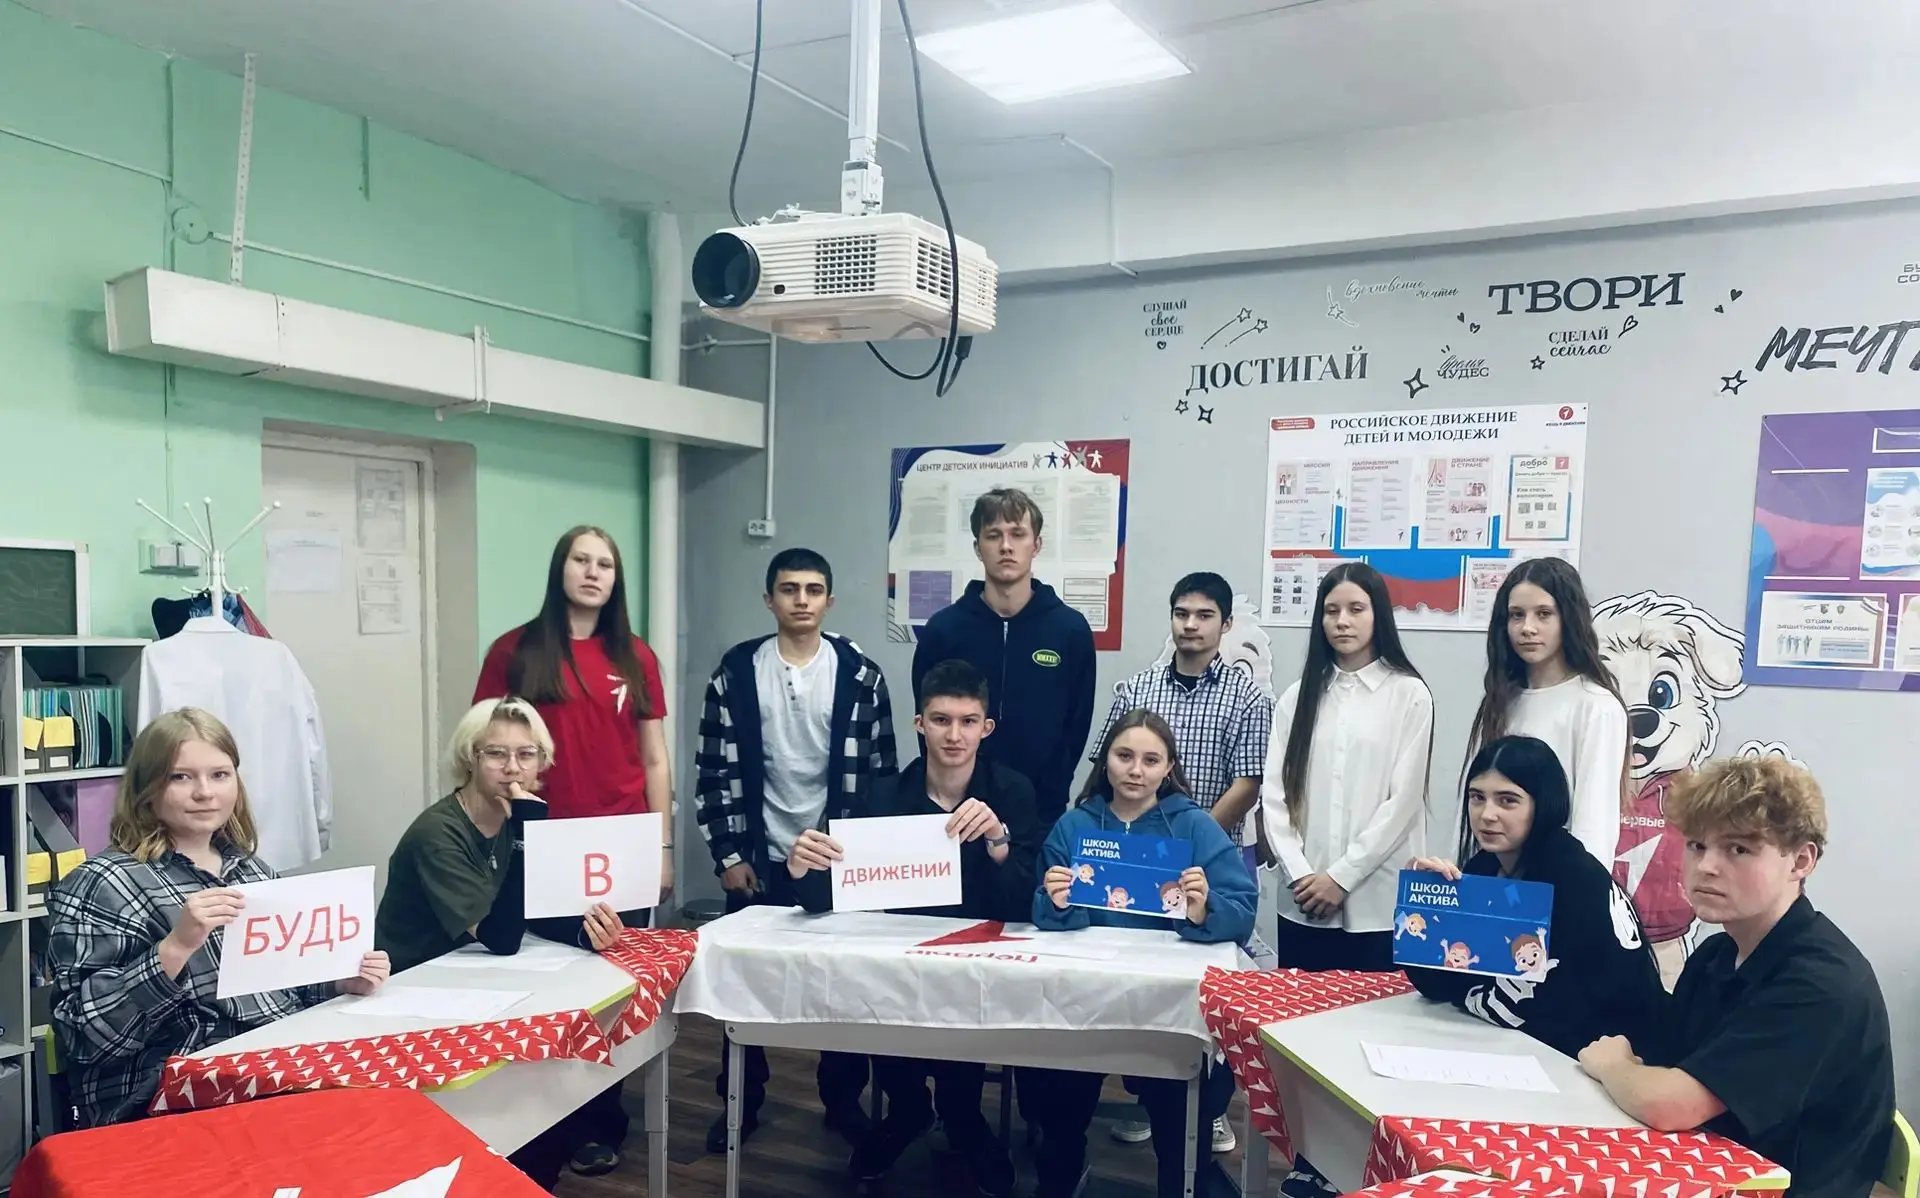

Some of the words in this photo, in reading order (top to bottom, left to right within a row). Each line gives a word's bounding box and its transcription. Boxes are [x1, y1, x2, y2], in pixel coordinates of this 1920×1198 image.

[1488, 272, 1686, 315] ТВОРИ
[1145, 325, 1184, 337] СЕРДЦЕ
[1549, 326, 1608, 344] СДЕЛАЙ
[1550, 343, 1612, 357] сейчас
[1186, 345, 1368, 396] ДОСТИГАЙ
[1437, 367, 1489, 380] ЧУДЕС
[1330, 414, 1429, 430] РОССИЙСКОЕ
[1430, 411, 1518, 426] ДВИЖЕНИЕ
[1344, 429, 1390, 446] ДЕТЕЙ
[1393, 431, 1405, 443] И
[1407, 428, 1499, 443] МОЛОДЕЖИ
[916, 463, 942, 473] ЦЕНТР
[942, 462, 978, 472] ДЕТСКИХ
[979, 461, 1028, 471] ИНИЦИАТИВ
[1619, 813, 1665, 828] ервые
[1082, 838, 1120, 850] ШКОЛА
[1081, 848, 1121, 860] АКТИВА
[584, 853, 613, 897] В
[842, 861, 951, 888] ДВИЖЕНИИ
[1410, 882, 1458, 896] ШКОЛА
[1409, 893, 1460, 908] АКТИВА
[243, 903, 360, 957] БУДЬ
